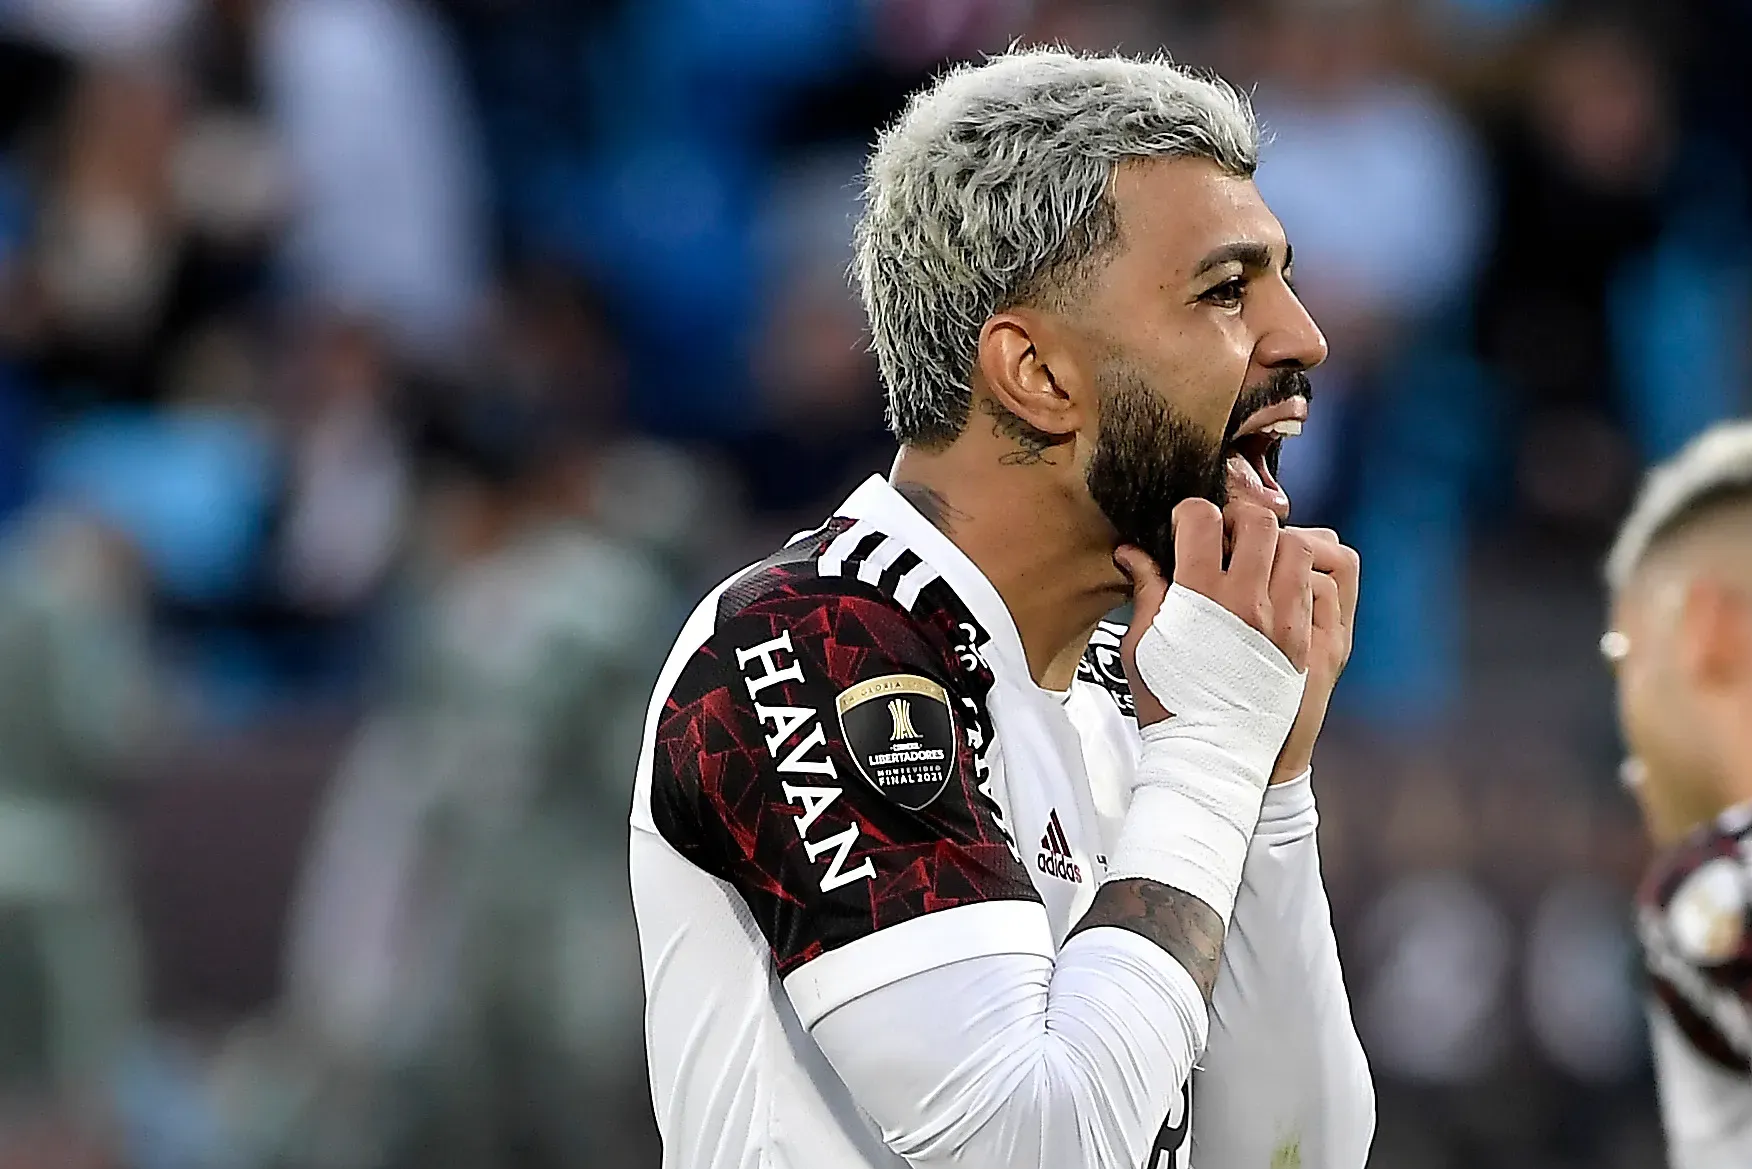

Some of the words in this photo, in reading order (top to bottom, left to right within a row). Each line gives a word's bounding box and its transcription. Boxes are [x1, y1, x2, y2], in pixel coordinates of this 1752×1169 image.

[735, 629, 877, 893] HAVAN
[868, 749, 945, 767] LIBERTADORES
[878, 774, 916, 787] FINAL
[917, 771, 943, 783] 2021
[1037, 850, 1083, 884] adidas
